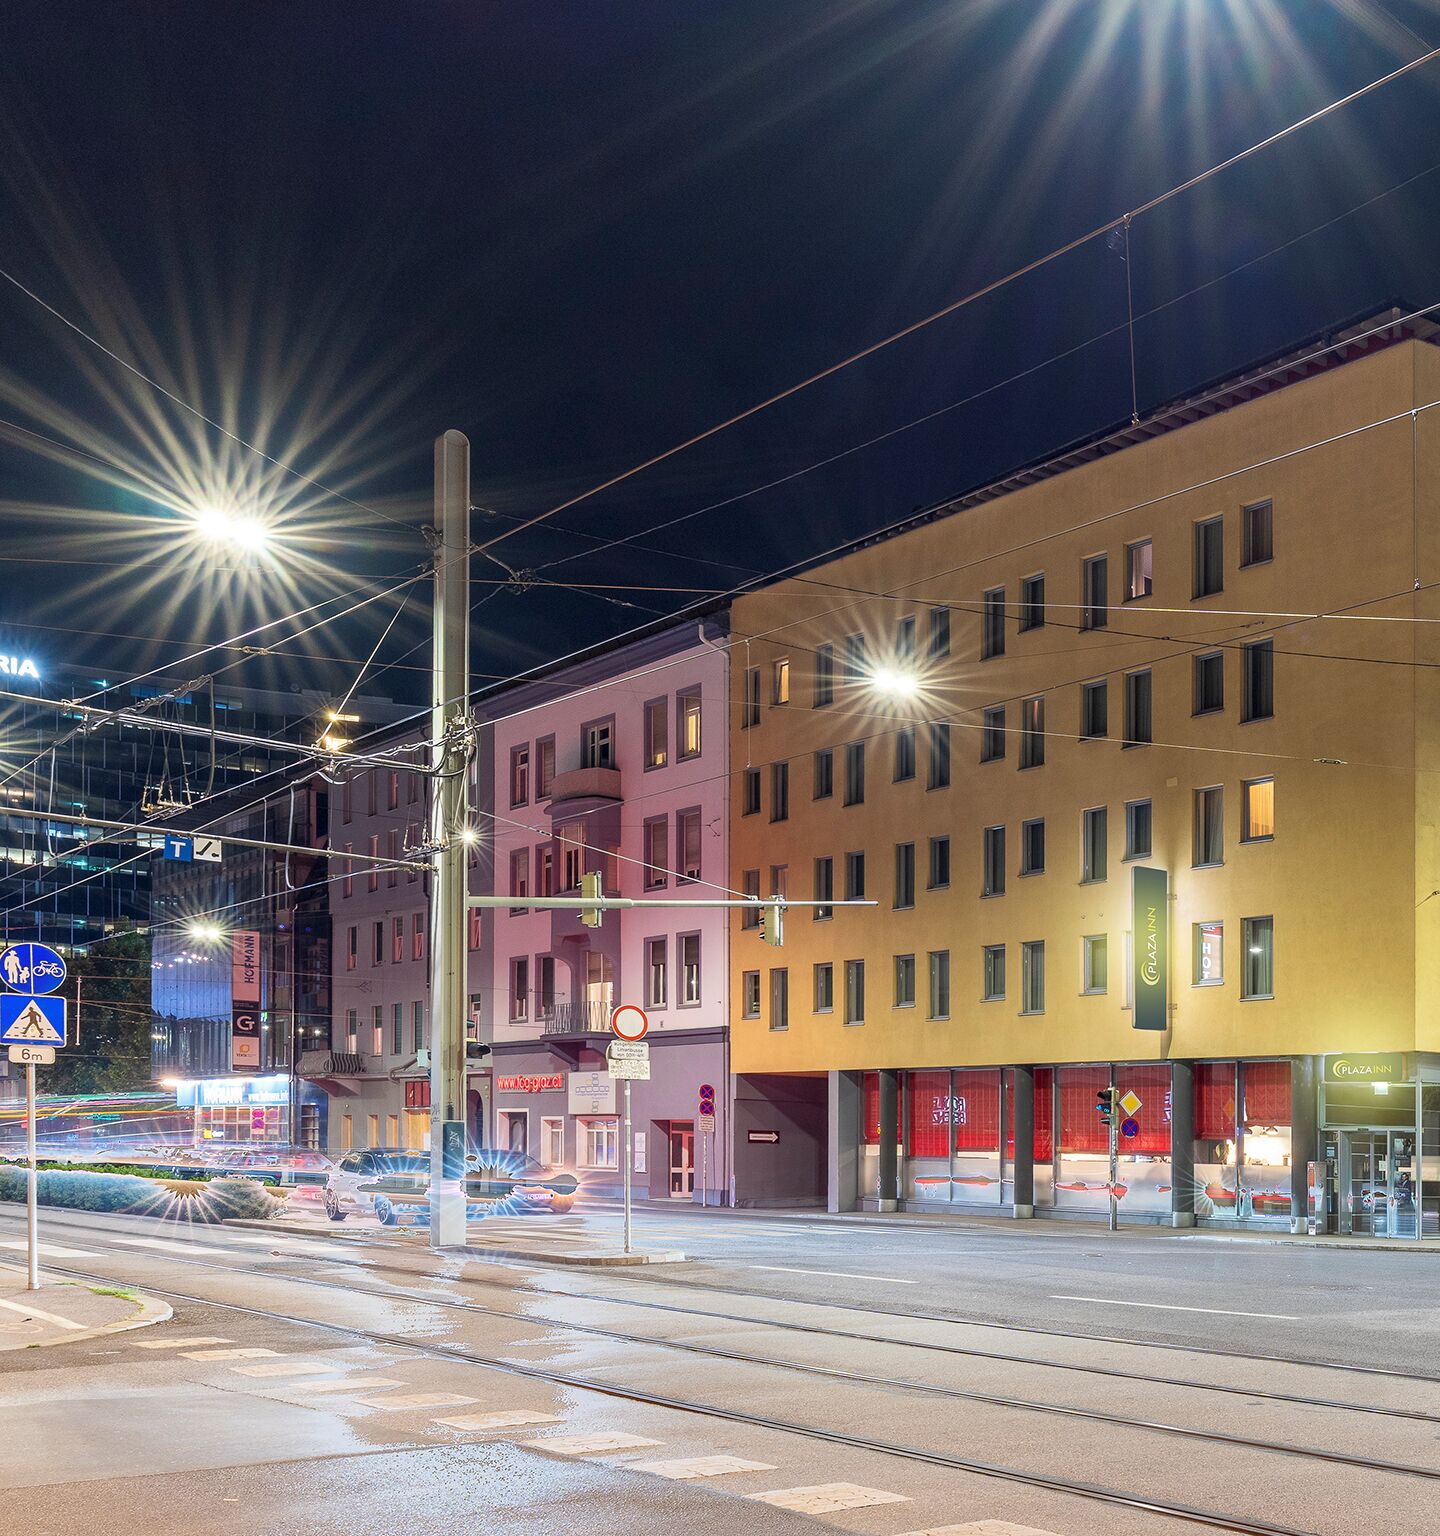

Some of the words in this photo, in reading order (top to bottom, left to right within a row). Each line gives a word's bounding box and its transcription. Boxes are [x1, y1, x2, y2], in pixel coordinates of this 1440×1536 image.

[170, 840, 187, 858] T
[1147, 906, 1157, 932] INN
[244, 935, 255, 984] HOFMANN
[1147, 933, 1157, 974] PLAZA
[1341, 1065, 1373, 1075] PLAZA
[1373, 1064, 1392, 1073] INN
